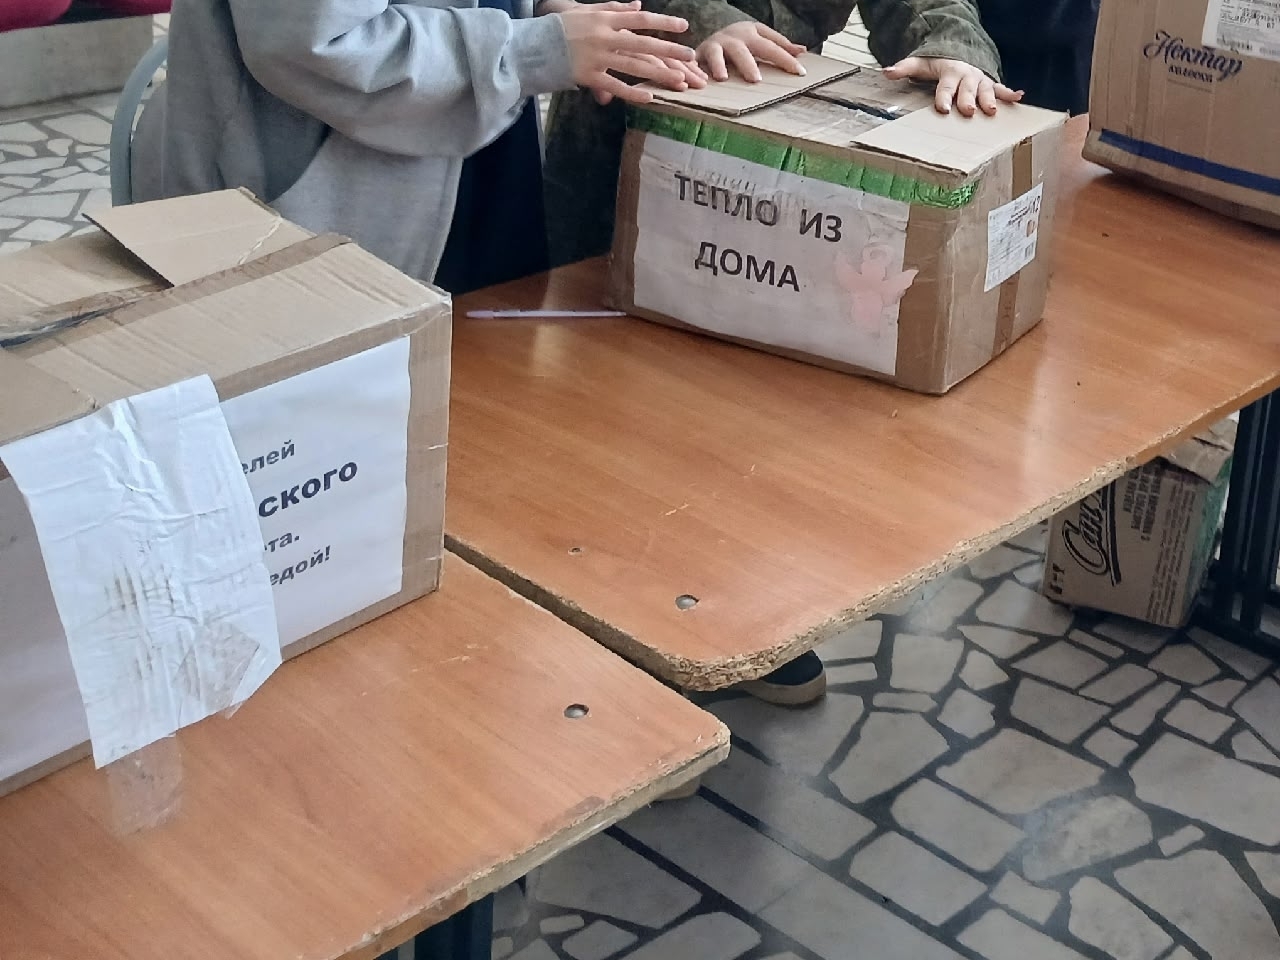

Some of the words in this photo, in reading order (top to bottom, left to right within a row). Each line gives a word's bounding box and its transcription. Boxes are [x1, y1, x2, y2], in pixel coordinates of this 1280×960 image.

[1143, 29, 1243, 82] Нектар
[673, 172, 779, 227] ТЕПЛО
[799, 207, 843, 244] ИЗ
[694, 241, 801, 293] ДОМА
[258, 461, 358, 517] ского
[263, 532, 300, 553] та.
